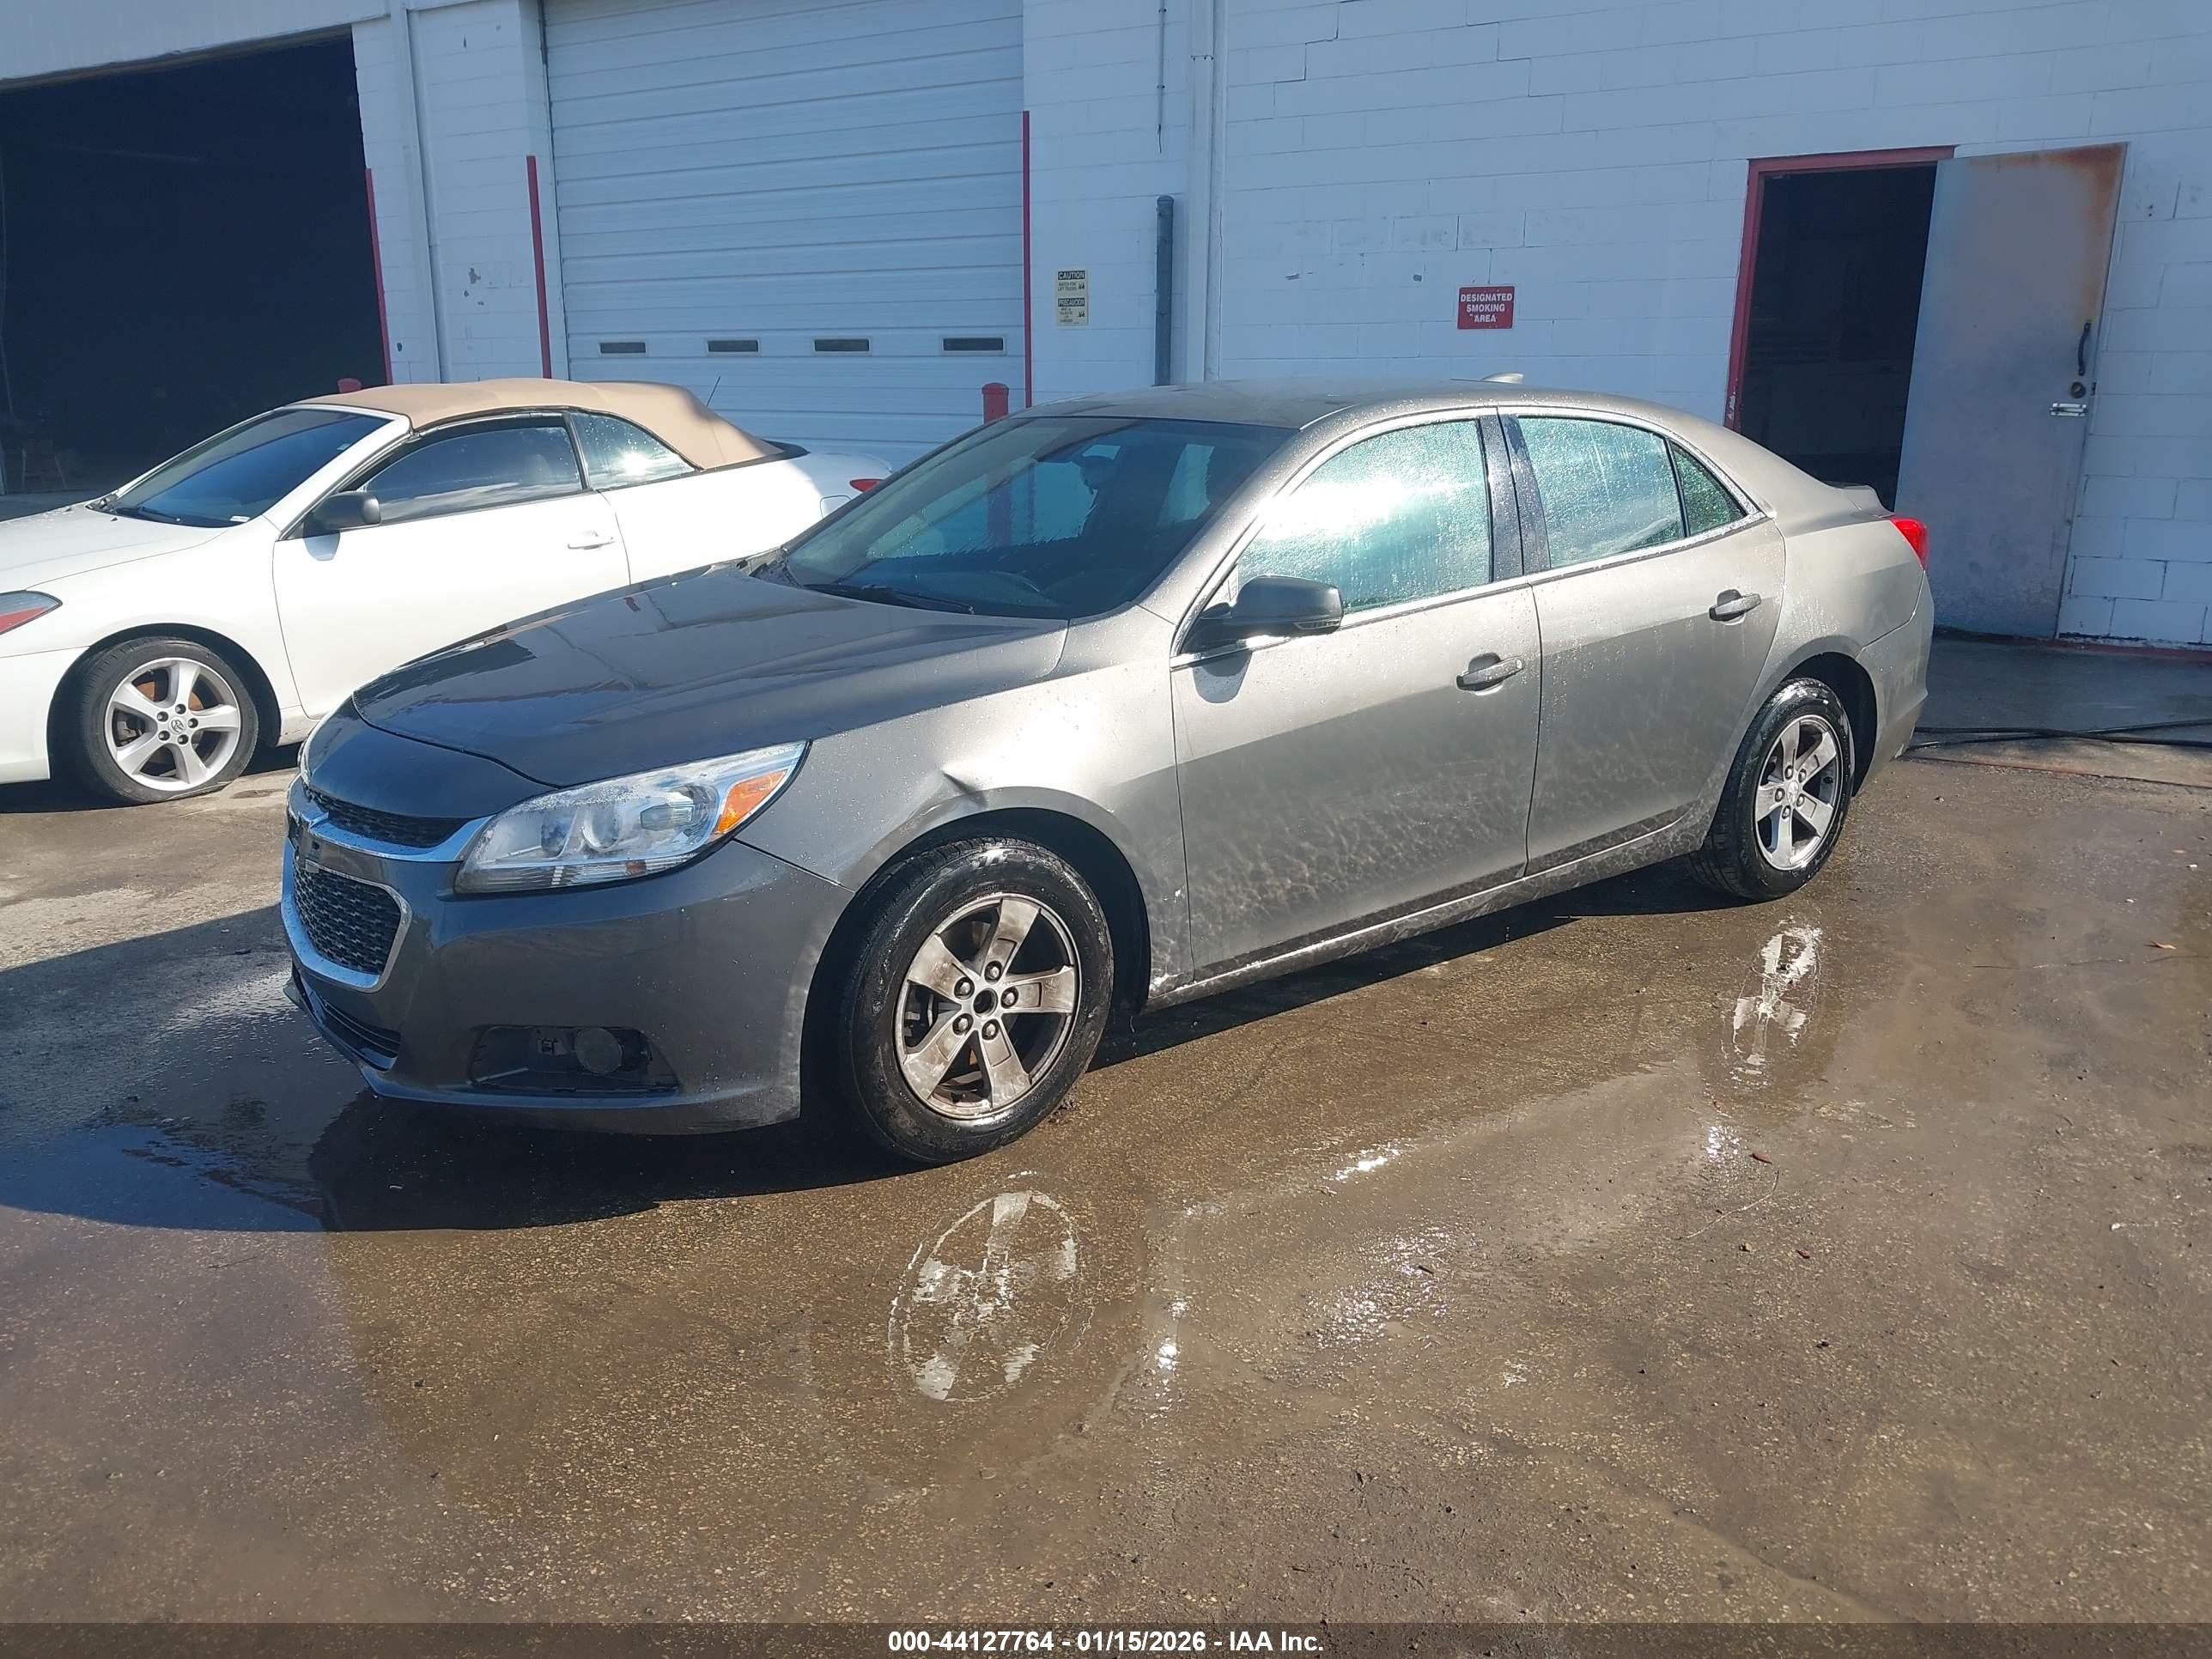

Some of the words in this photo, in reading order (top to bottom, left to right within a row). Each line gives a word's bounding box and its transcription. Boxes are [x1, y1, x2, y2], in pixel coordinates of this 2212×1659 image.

[1461, 293, 1512, 302] DESIGNATED
[1466, 303, 1505, 313] SMOKING
[1474, 313, 1497, 323] AREA
